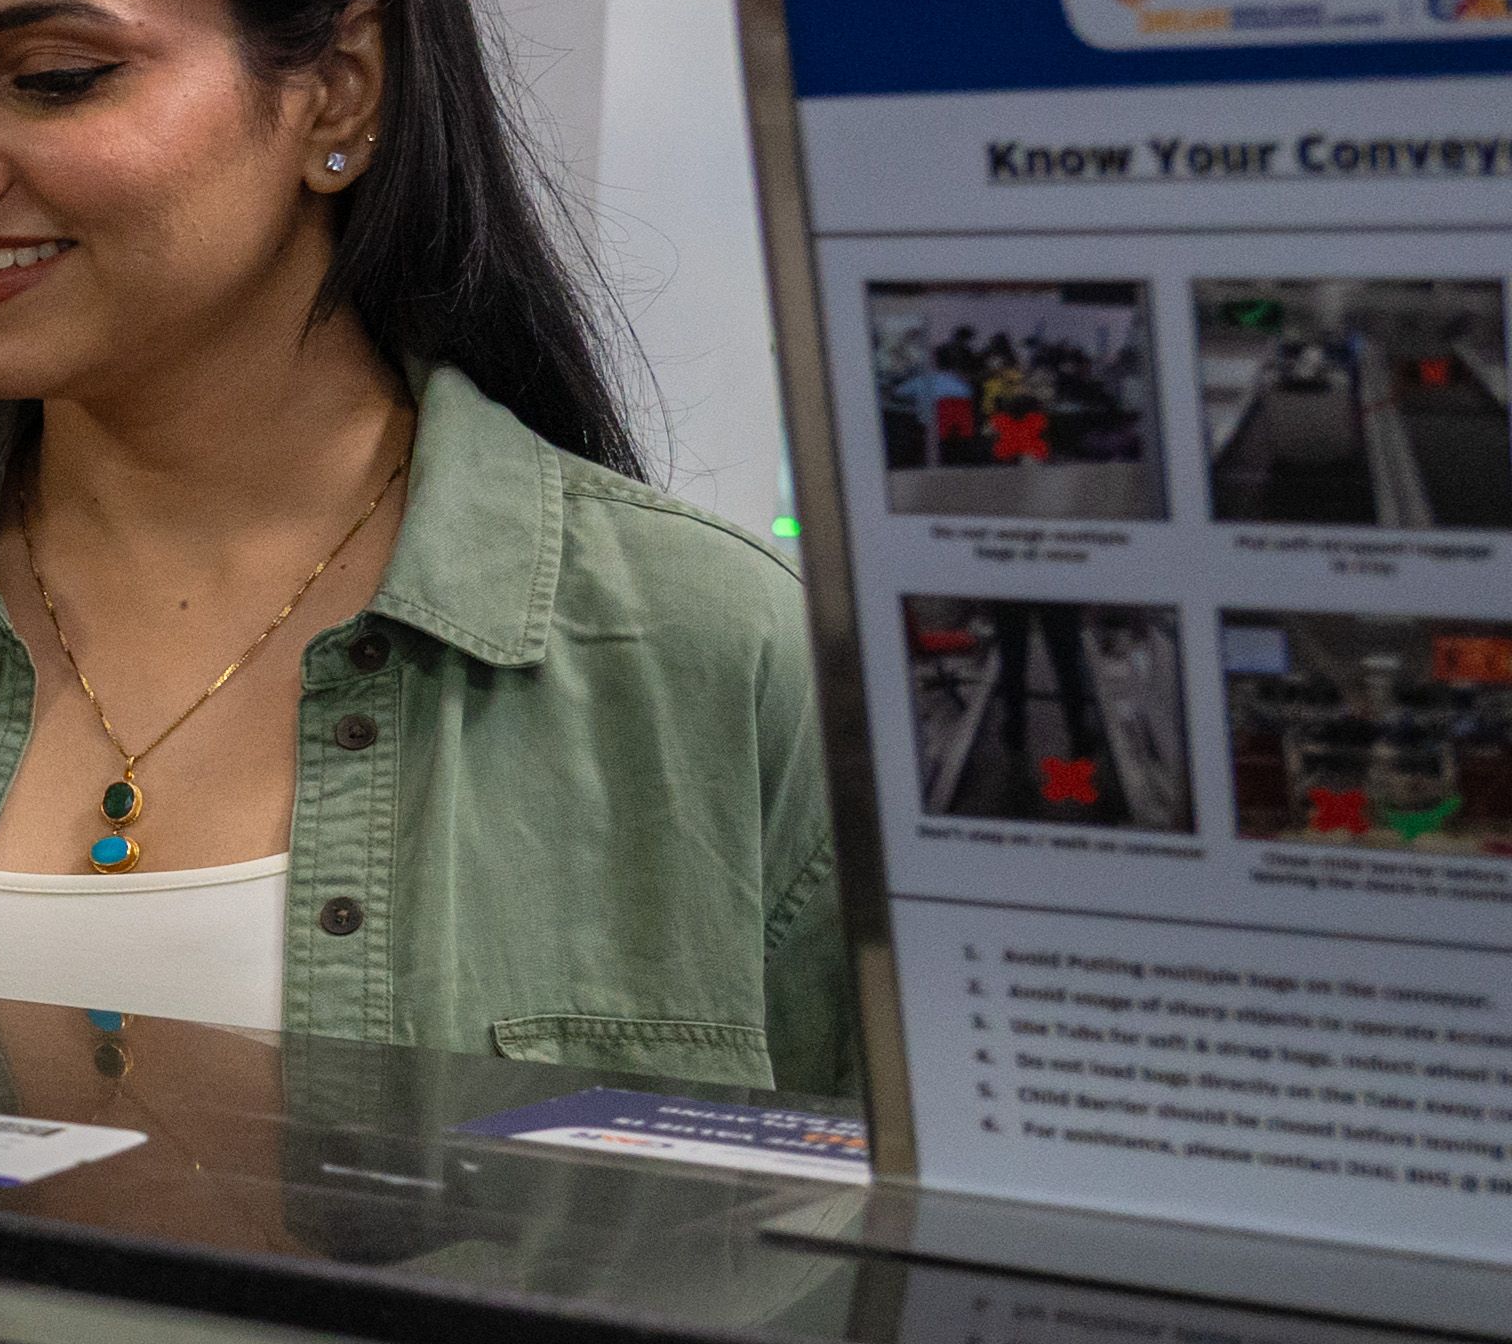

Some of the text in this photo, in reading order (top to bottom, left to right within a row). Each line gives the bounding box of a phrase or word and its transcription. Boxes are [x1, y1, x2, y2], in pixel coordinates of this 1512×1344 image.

[987, 134, 1512, 181] Know Your Convey
